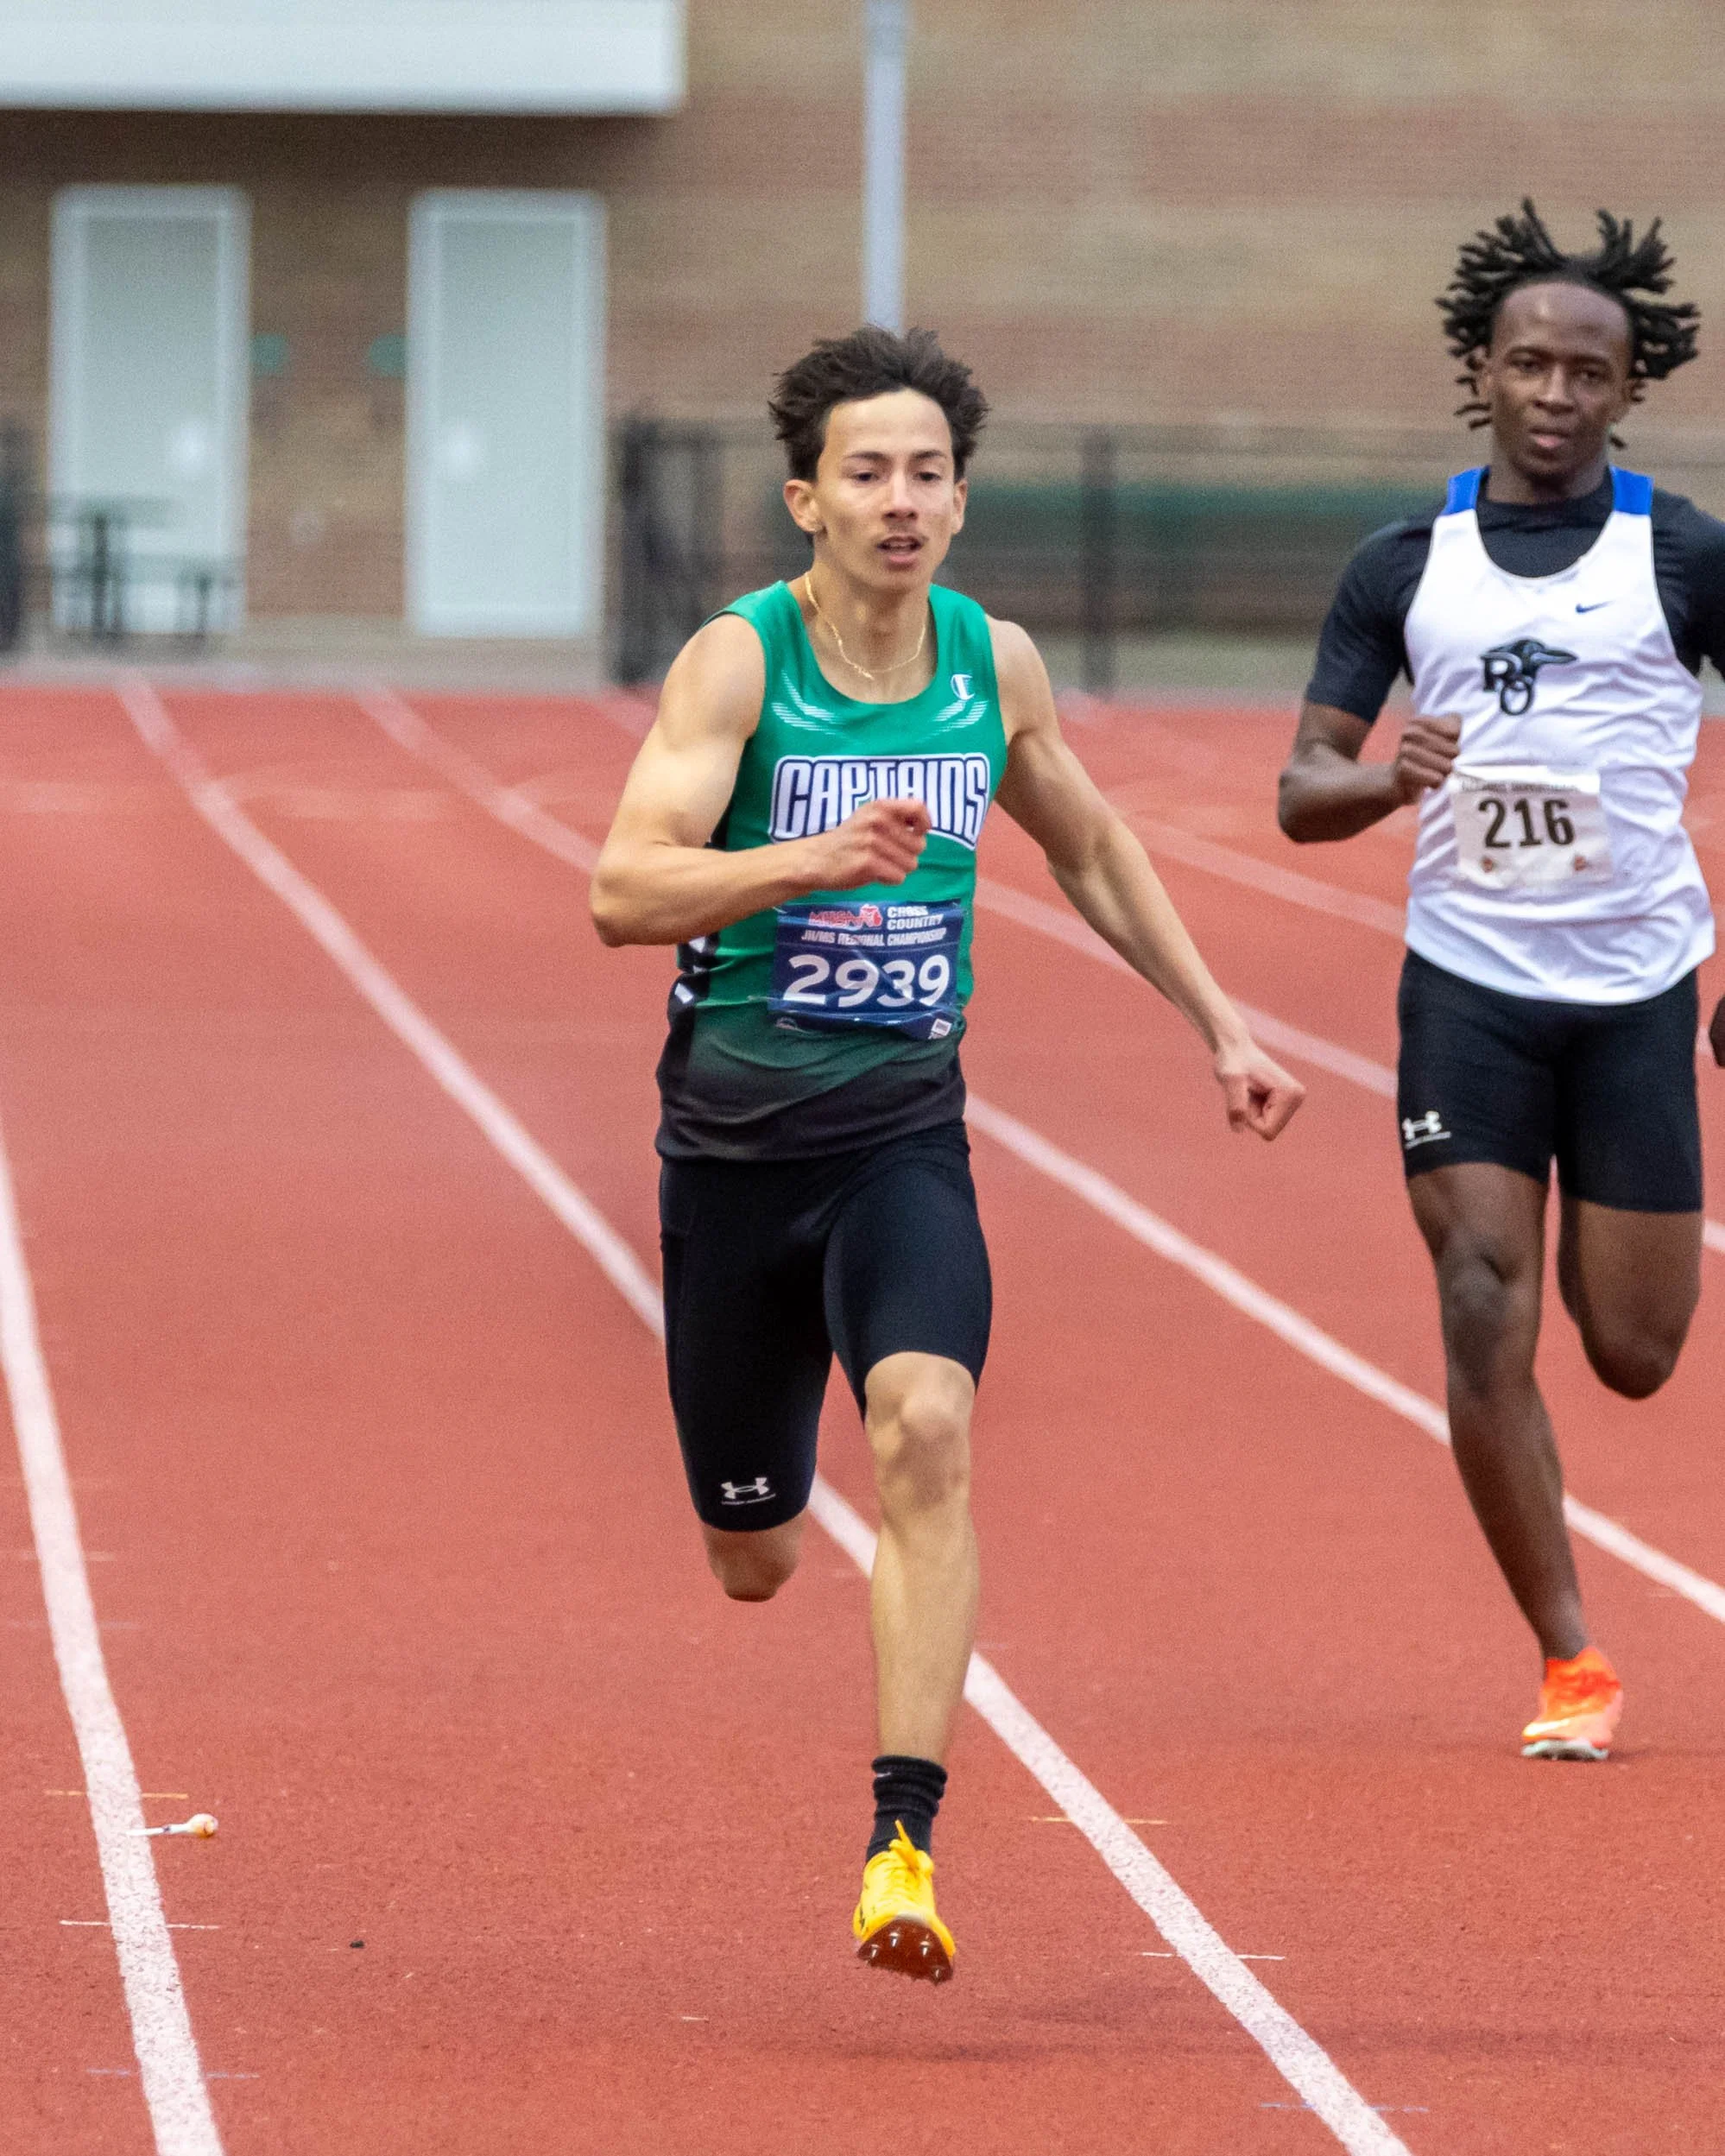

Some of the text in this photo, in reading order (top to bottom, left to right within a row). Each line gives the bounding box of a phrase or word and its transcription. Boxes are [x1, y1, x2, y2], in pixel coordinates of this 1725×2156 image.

[769, 754, 989, 850] CAPTAINS
[1478, 798, 1576, 849] 216
[887, 914, 944, 930] COUNTRY
[782, 954, 950, 1008] 2939
